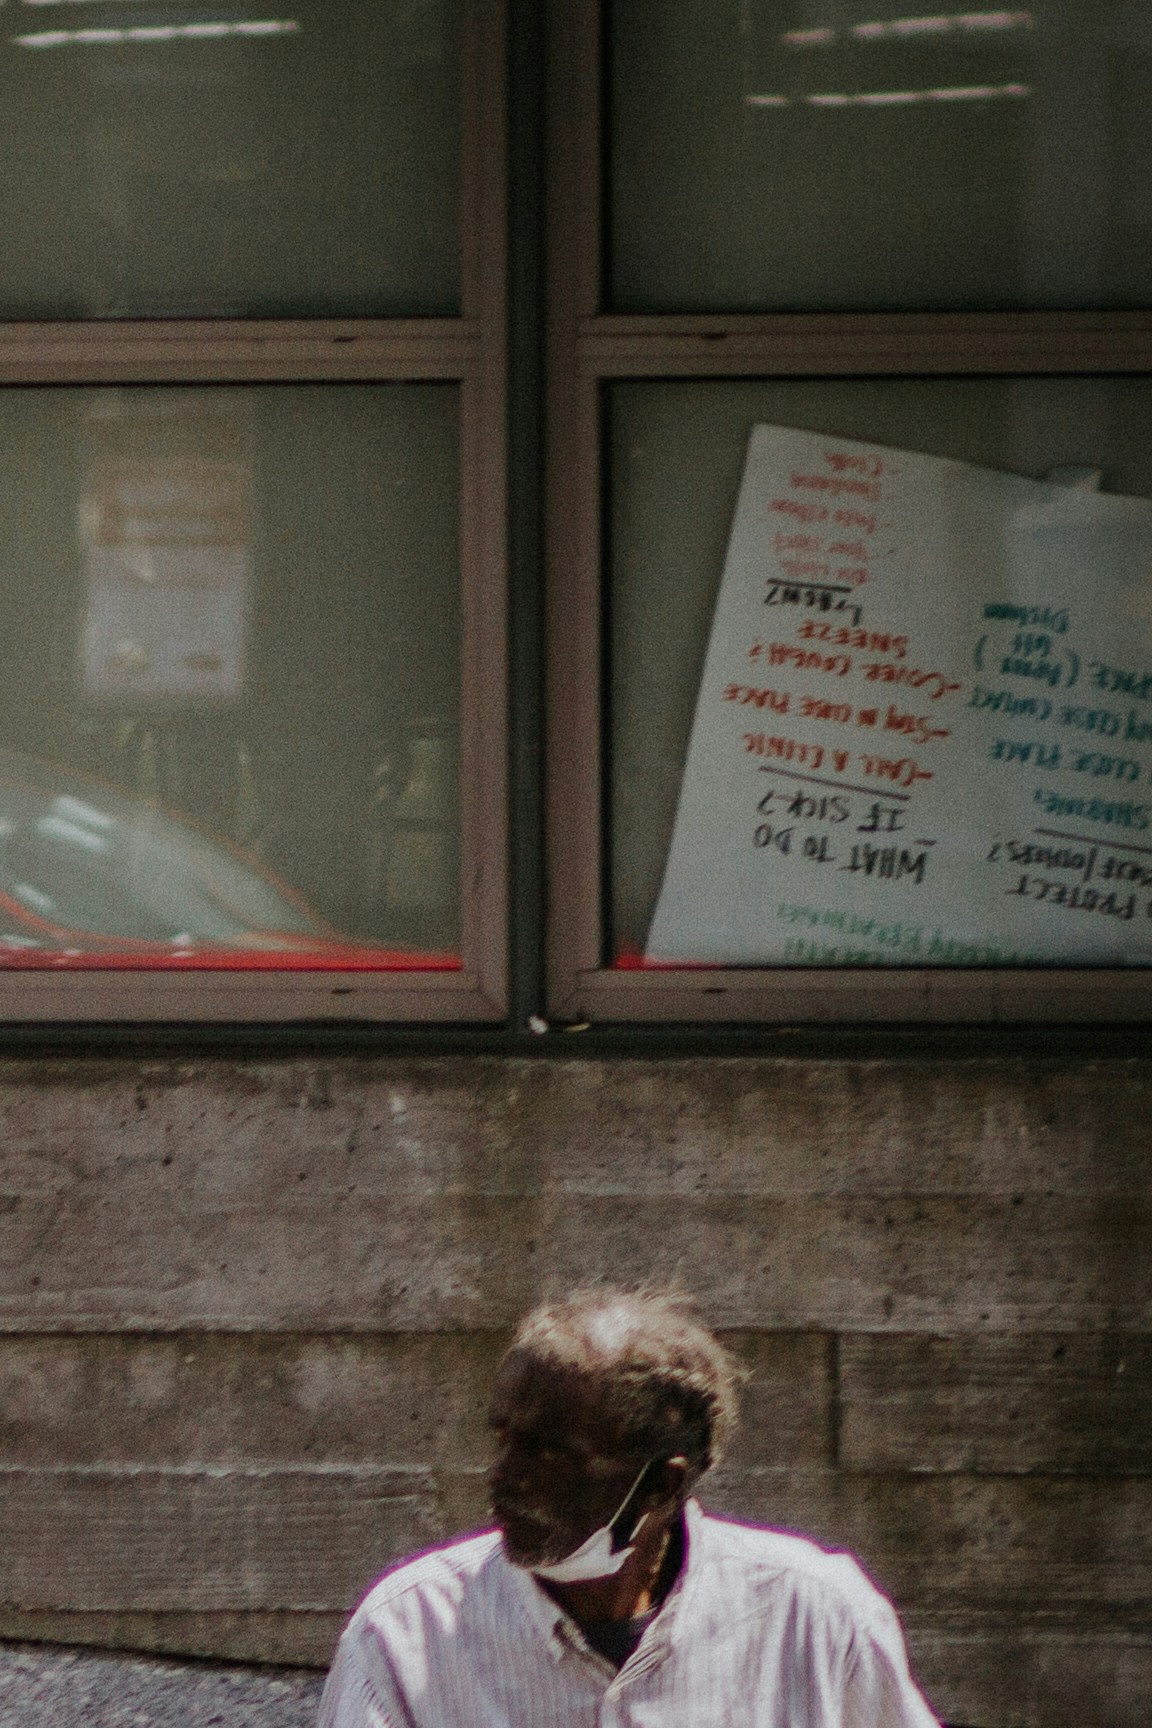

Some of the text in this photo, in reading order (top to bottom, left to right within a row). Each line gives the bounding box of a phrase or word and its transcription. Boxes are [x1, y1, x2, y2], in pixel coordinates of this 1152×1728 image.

[722, 683, 790, 715] PLACE
[742, 733, 823, 770] CLINIC
[988, 739, 1062, 771] PLACE
[757, 790, 904, 834] IF SICK?
[753, 824, 927, 886] WHAT TO DO
[1004, 875, 1136, 921] PROTECT
